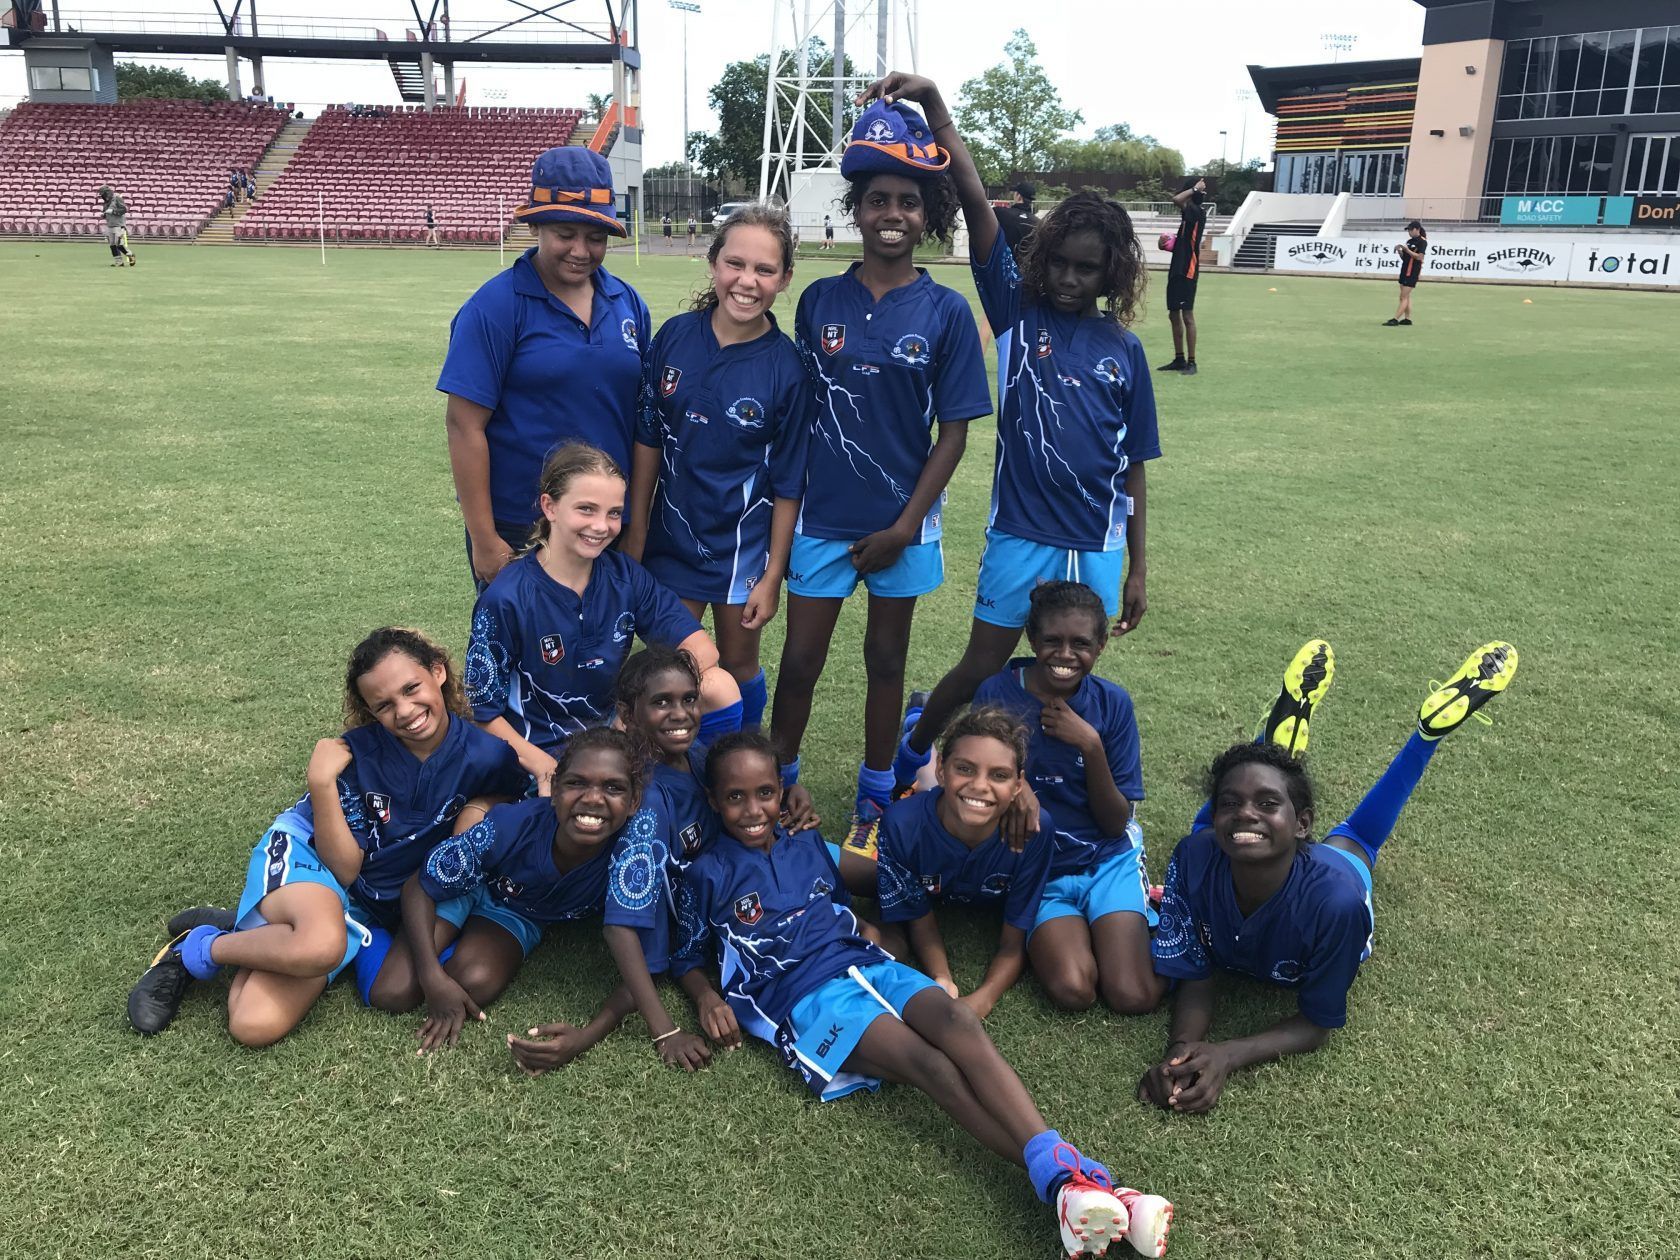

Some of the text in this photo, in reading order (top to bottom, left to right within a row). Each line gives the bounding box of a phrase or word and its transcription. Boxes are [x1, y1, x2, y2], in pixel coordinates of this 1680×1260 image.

[1518, 200, 1564, 213] MACC
[1538, 214, 1562, 222] SAFETY
[1288, 242, 1347, 259] SHERRIN
[1358, 243, 1368, 253] If
[1371, 243, 1389, 254] it's
[1430, 246, 1476, 257] Sherrin
[1486, 247, 1556, 266] SHERRIN
[1355, 257, 1480, 271] it's just football
[1589, 252, 1670, 275] total
[545, 641, 555, 650] NT
[373, 800, 384, 808] NT
[741, 902, 753, 911] NT
[816, 1022, 844, 1059] BLK
